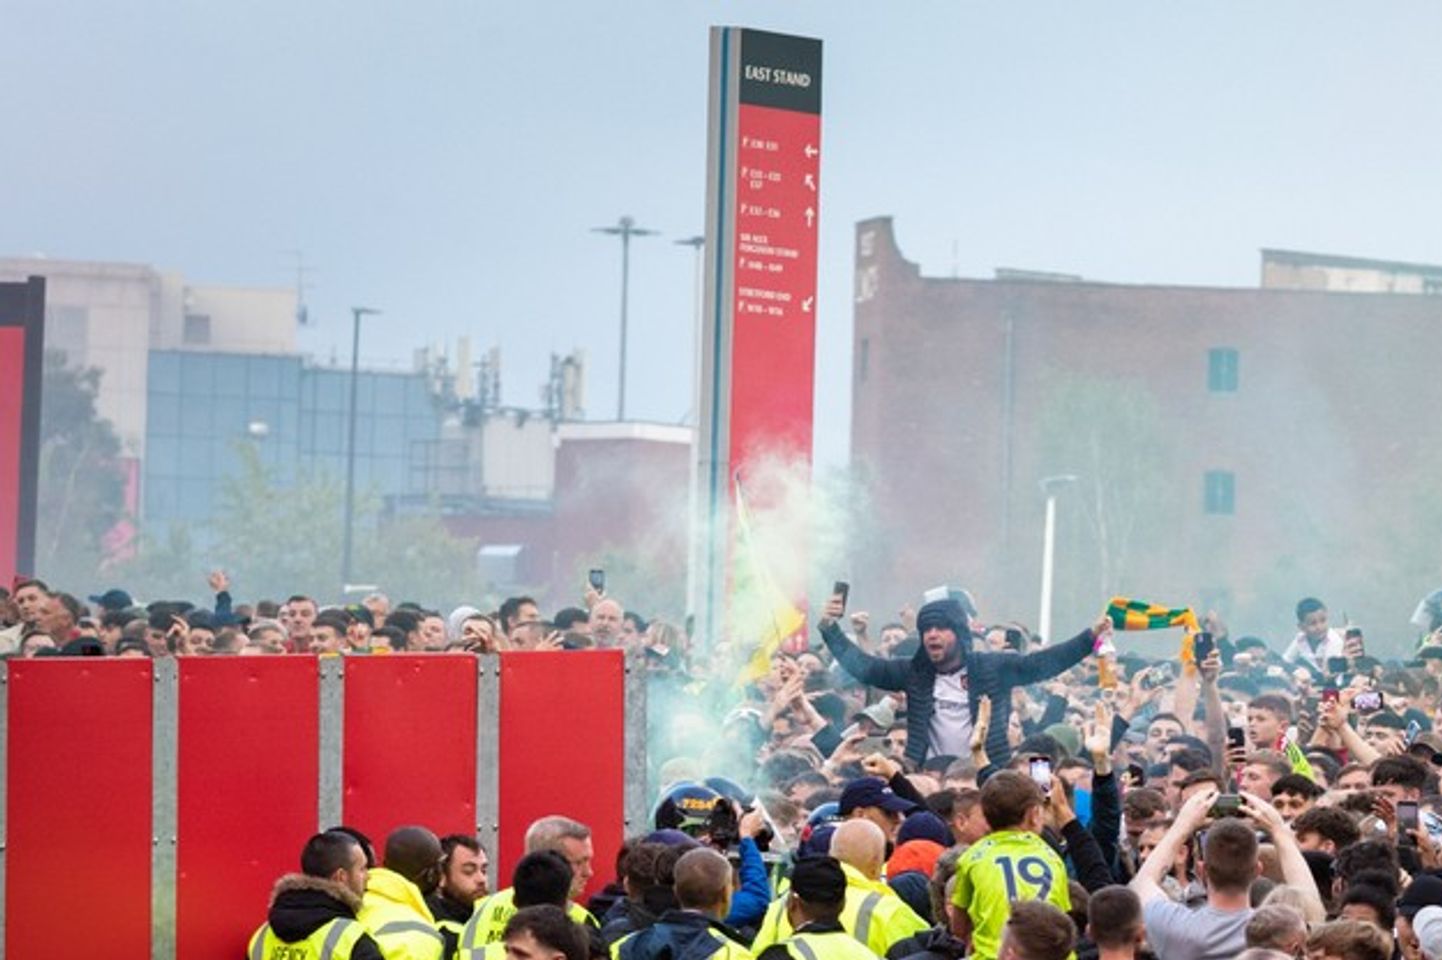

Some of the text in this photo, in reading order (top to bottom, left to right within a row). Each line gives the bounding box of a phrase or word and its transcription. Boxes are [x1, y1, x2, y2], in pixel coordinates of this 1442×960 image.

[745, 65, 811, 87] EAST STAND
[995, 856, 1053, 902] 19
